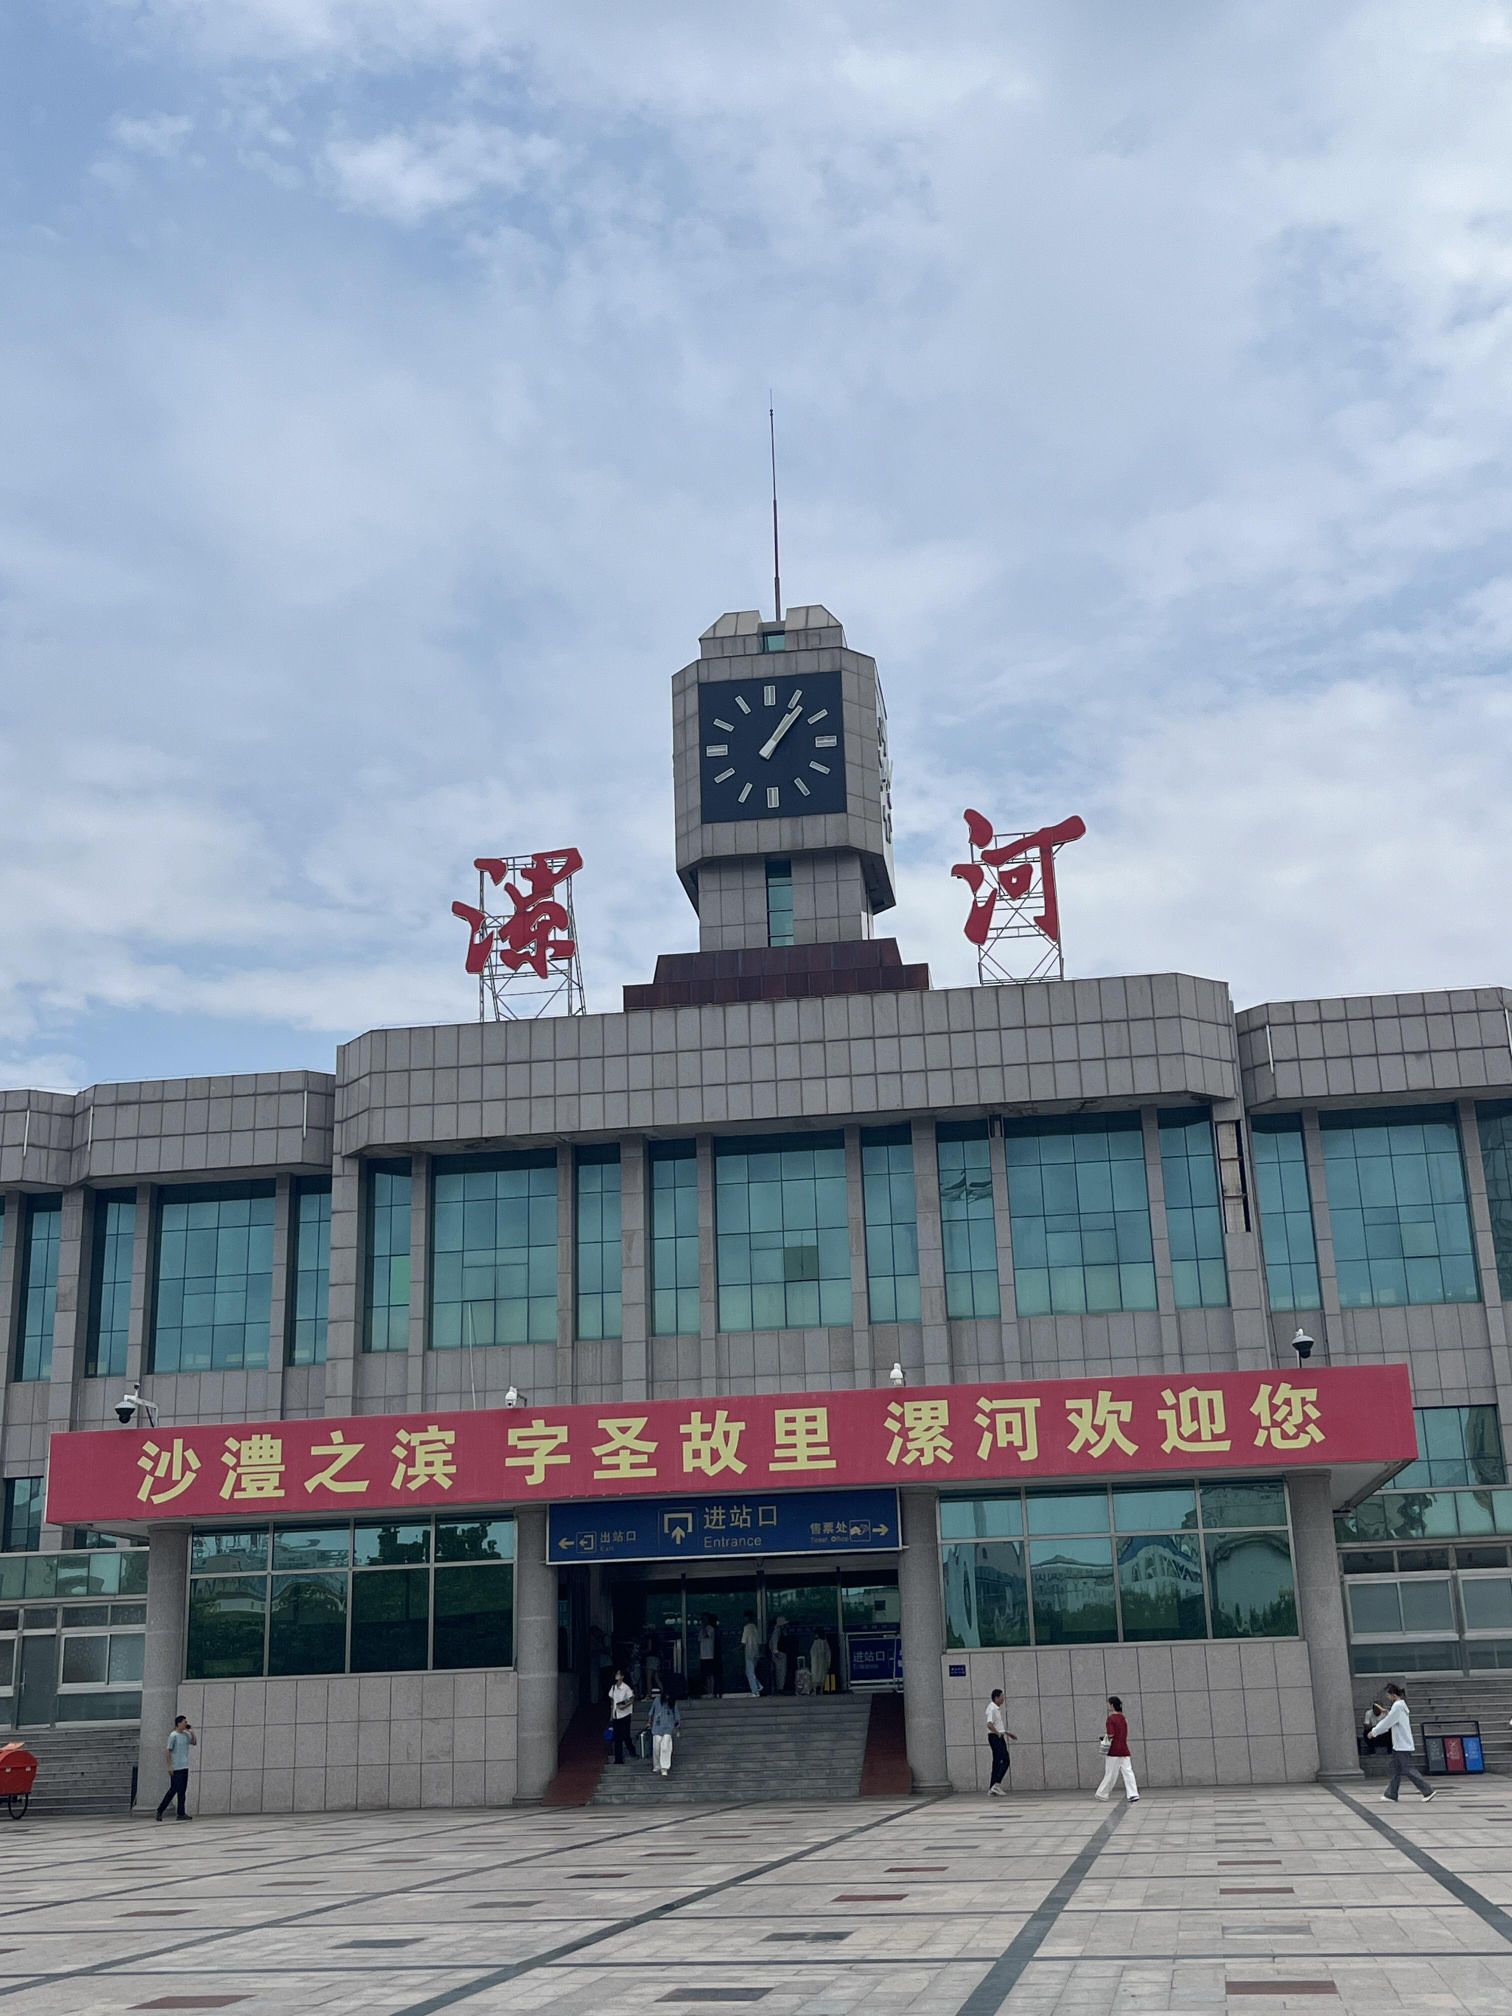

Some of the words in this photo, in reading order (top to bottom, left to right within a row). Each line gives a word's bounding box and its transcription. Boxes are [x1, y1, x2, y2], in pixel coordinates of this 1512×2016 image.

[452, 847, 584, 979] 漯
[951, 808, 1086, 943] 河
[136, 1425, 458, 1504] 沙澧之滨
[505, 1406, 838, 1486] 字圣故里
[883, 1383, 1325, 1466] 漯河欢迎您
[703, 1505, 777, 1530] 进站口
[810, 1521, 848, 1535] 售票处
[599, 1531, 637, 1544] 出站口
[704, 1535, 762, 1549] Entrance
[853, 1650, 885, 1663] 进站口
